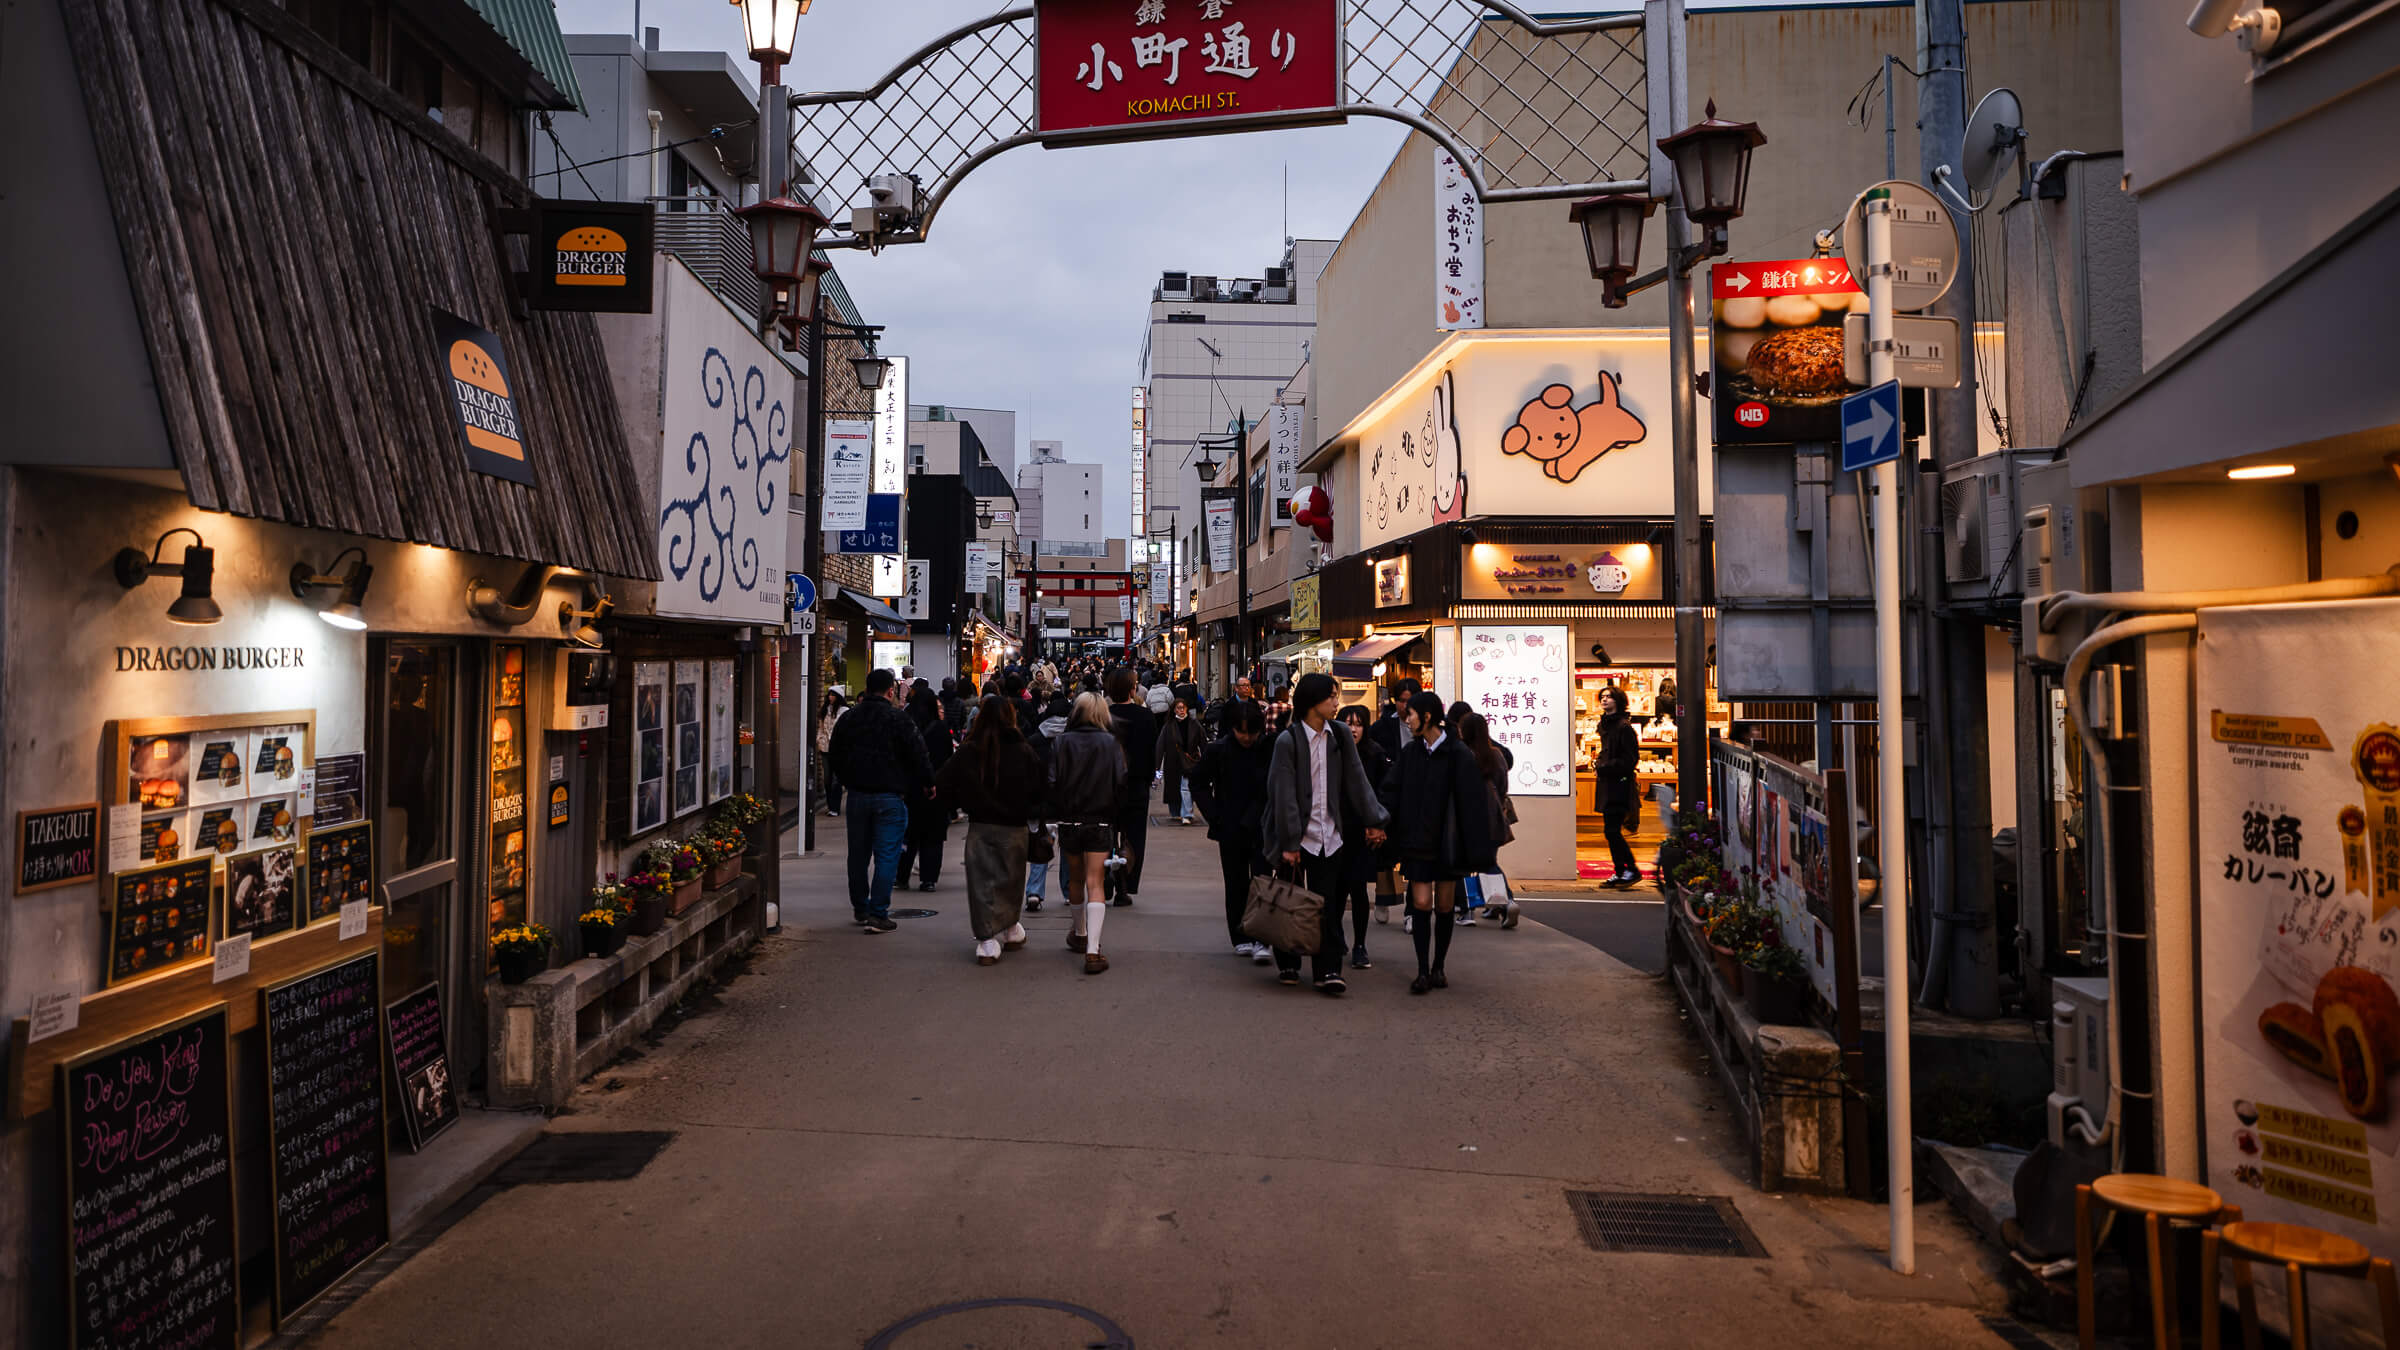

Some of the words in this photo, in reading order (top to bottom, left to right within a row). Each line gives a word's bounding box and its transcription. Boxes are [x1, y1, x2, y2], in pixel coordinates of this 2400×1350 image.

[1135, 0, 1233, 26] 鎌倉
[1076, 21, 1296, 91] 小町通り
[1127, 94, 1211, 117] KOMACHI
[1216, 91, 1241, 109] ST.
[1461, 192, 1475, 245] みっふぃー
[1444, 204, 1463, 278] おやつ堂
[556, 251, 627, 264] DRAGON
[556, 263, 626, 275] BURGER
[454, 378, 514, 420] DRAGON
[459, 401, 520, 441] BURGER
[115, 646, 216, 673] DRAGON
[222, 647, 305, 669] BURGER
[1494, 675, 1540, 686] なごみの
[1481, 690, 1549, 710] 和雑貨と
[1484, 712, 1551, 727] おやつの
[1498, 732, 1534, 745] 専門店
[2227, 744, 2255, 755] Winner
[2256, 744, 2264, 755] of
[2264, 749, 2310, 760] numerous
[2232, 757, 2253, 768] curry
[2254, 759, 2269, 768] pan
[2269, 760, 2304, 771] awards.
[492, 793, 523, 813] DRAGON
[492, 806, 523, 823] BURGER
[2224, 854, 2335, 899] カレーパン
[84, 1072, 114, 1112] Do
[114, 1056, 153, 1111] You
[151, 1027, 203, 1103] Know
